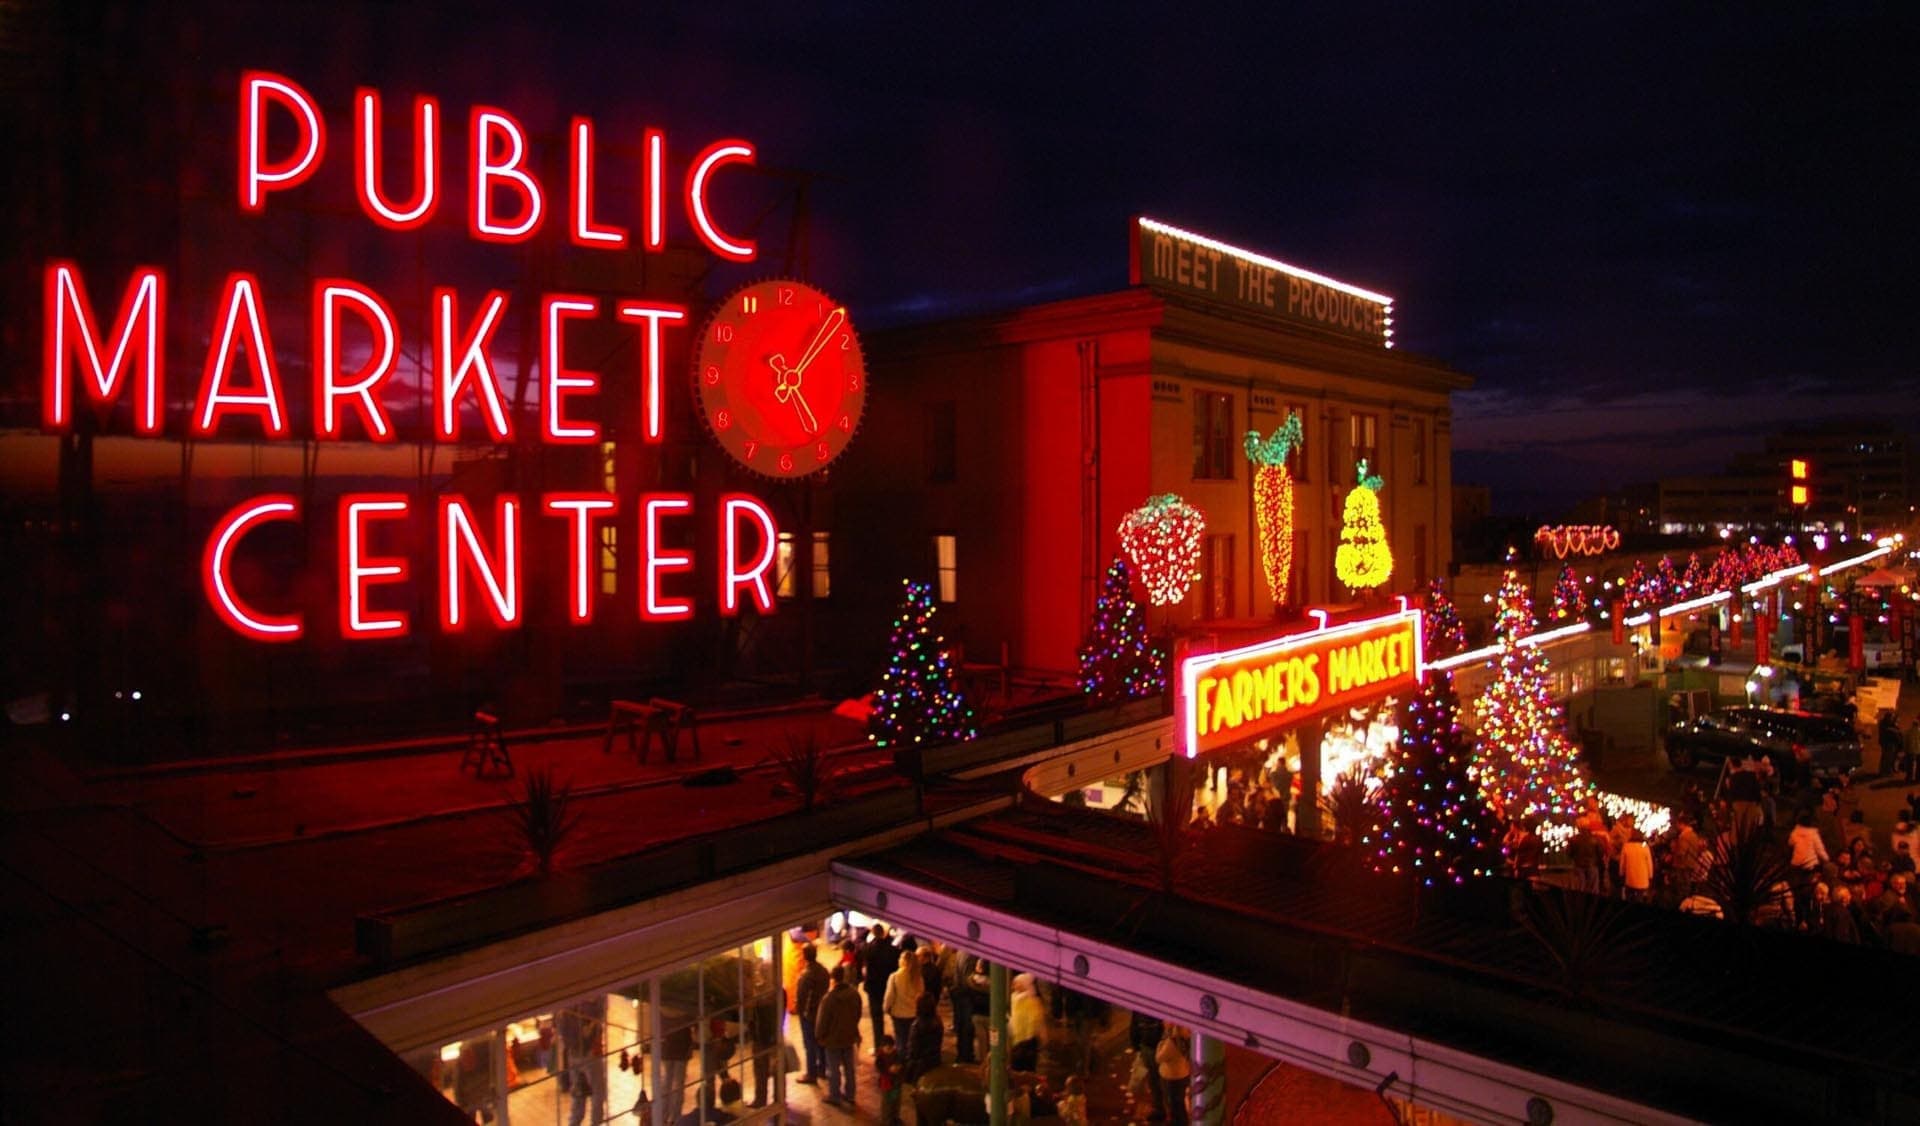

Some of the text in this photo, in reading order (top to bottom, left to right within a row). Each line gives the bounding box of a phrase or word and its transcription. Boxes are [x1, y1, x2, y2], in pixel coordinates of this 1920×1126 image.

[244, 75, 755, 260] PUBLIC
[1153, 234, 1382, 336] MEET THE PRODUCER
[743, 296, 757, 314] 11
[778, 288, 794, 305] 12
[716, 326, 733, 342] 10
[841, 334, 850, 350] 2
[49, 267, 687, 439] MARKET
[707, 366, 719, 385] 9
[851, 375, 859, 391] 3
[717, 411, 729, 428] 8
[744, 443, 755, 459] 7
[818, 444, 828, 460] 5
[780, 454, 793, 471] 6
[206, 494, 777, 638] CENTER
[1197, 630, 1412, 736] FARMERS MARKET
